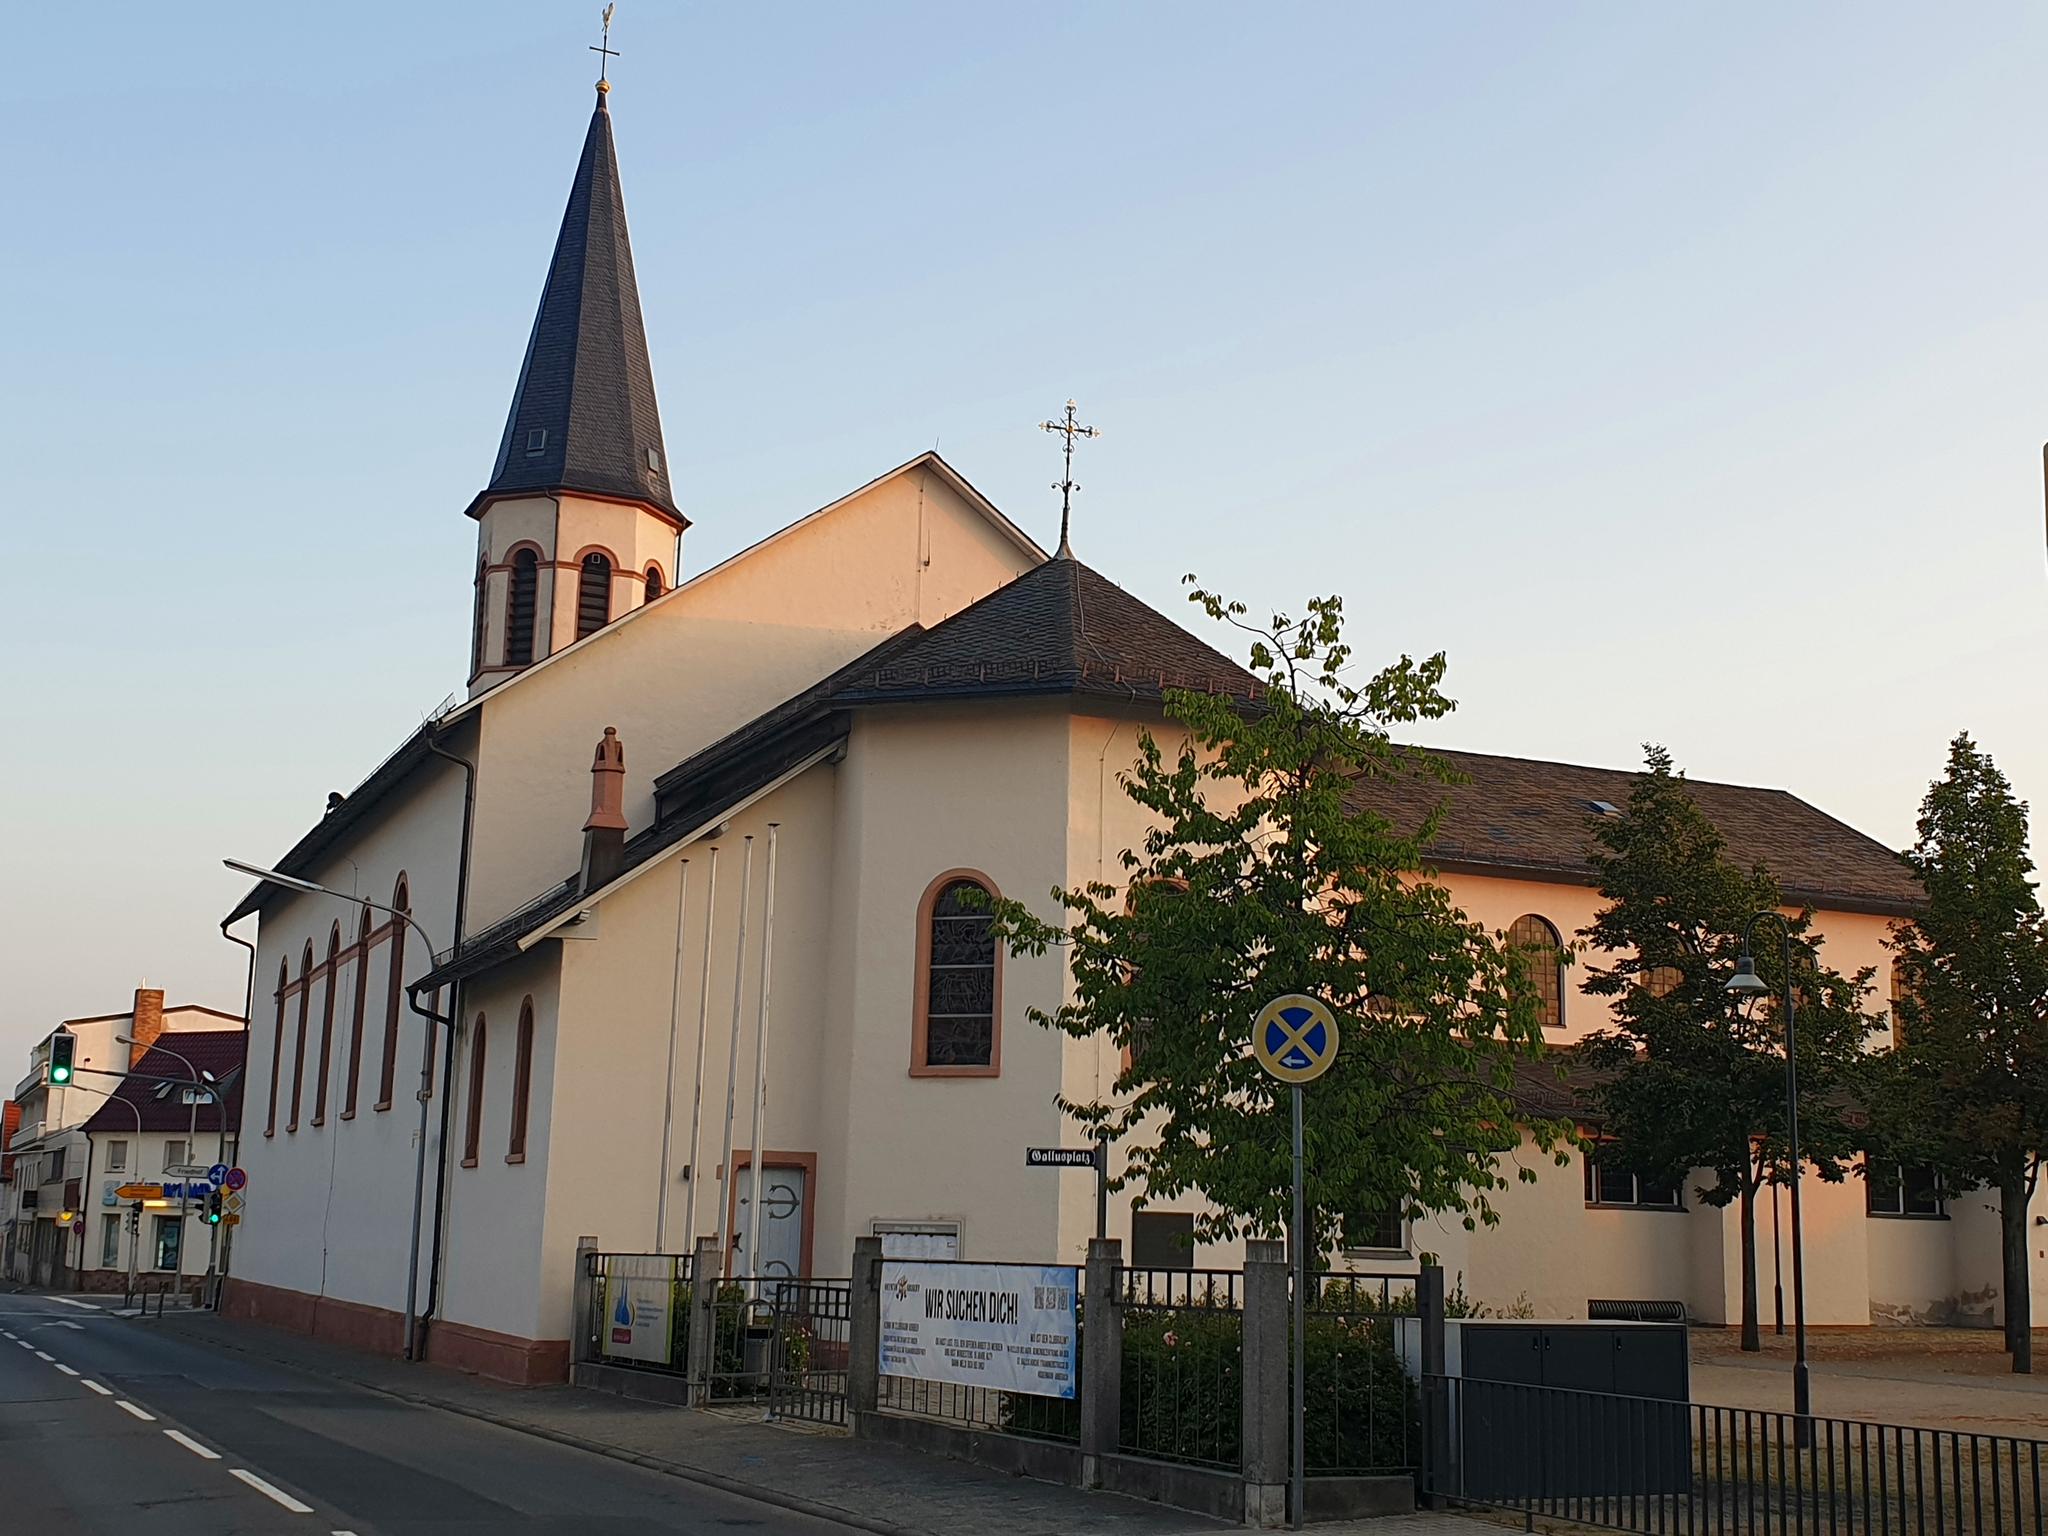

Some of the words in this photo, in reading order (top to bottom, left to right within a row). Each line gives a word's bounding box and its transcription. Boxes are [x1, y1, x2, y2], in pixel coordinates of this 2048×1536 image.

[1031, 1150, 1091, 1165] Gallusplatz
[925, 1288, 944, 1319] WIR
[945, 1289, 987, 1323] SUCHEN
[989, 1291, 1018, 1325] DICH!
